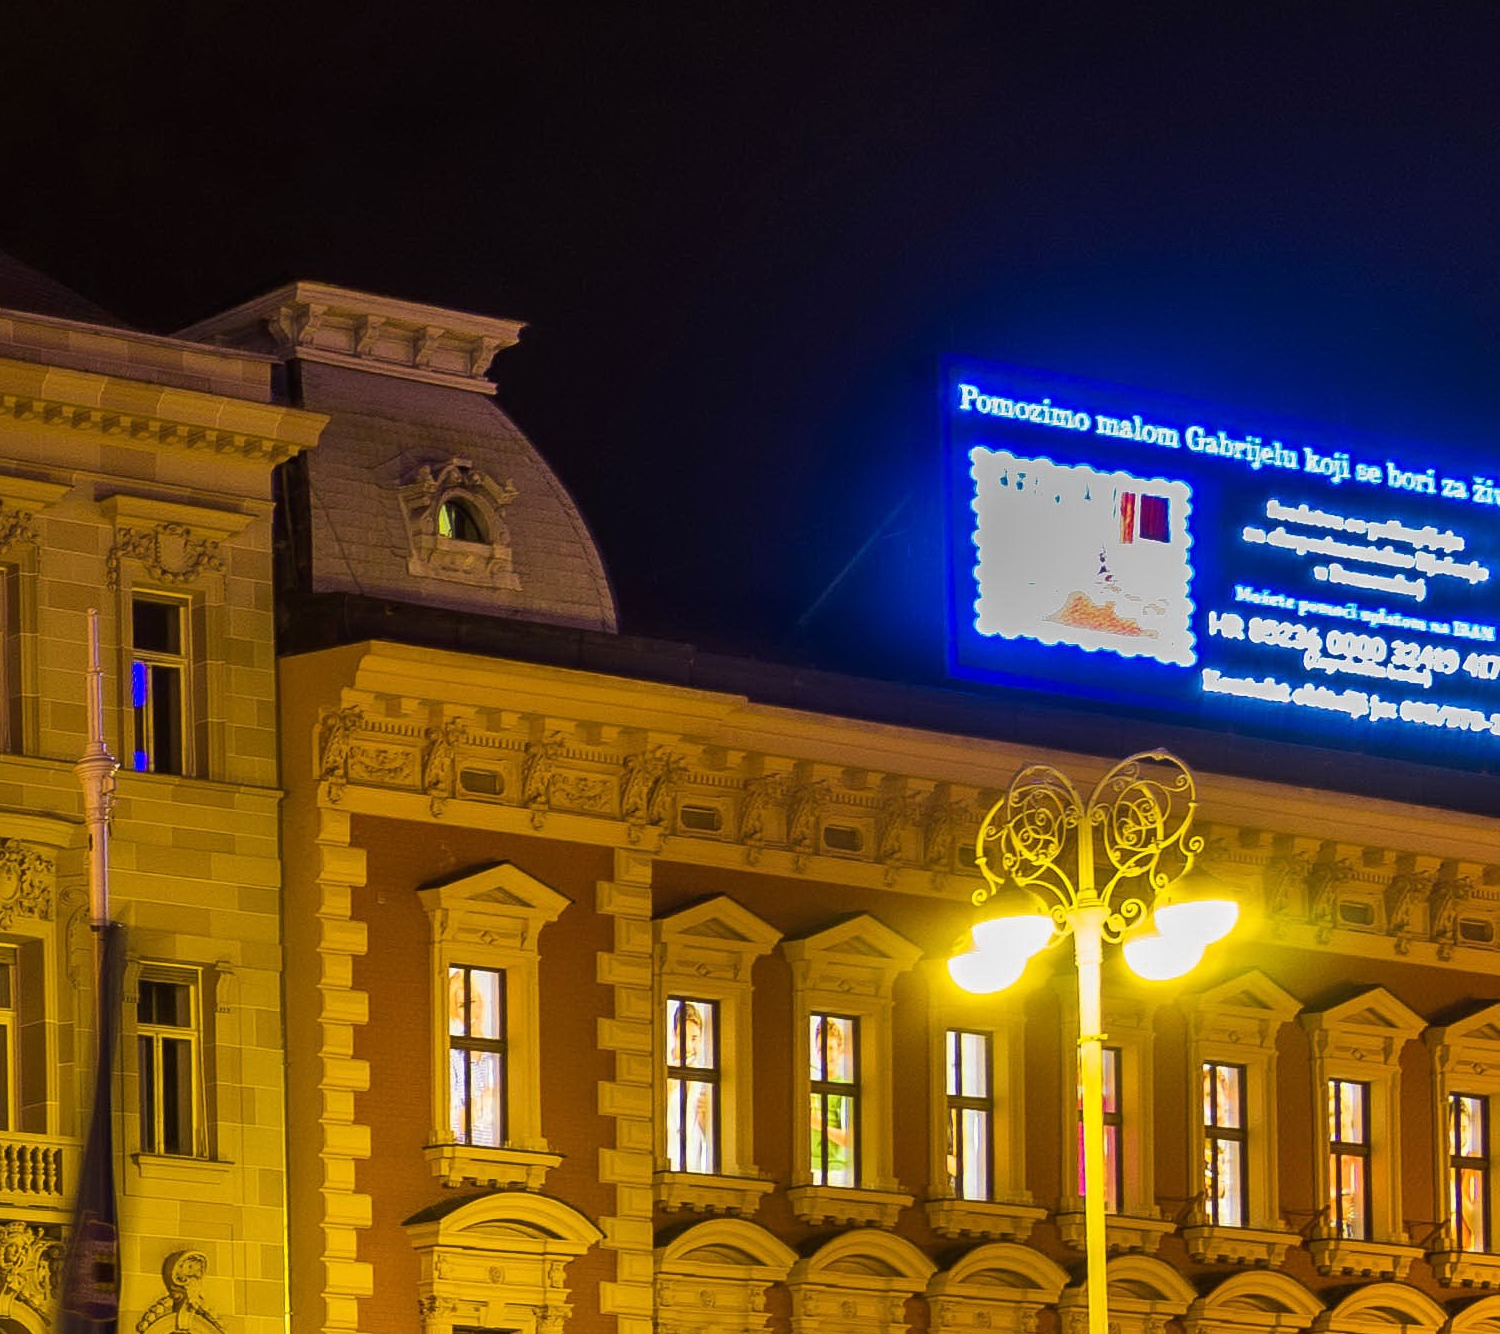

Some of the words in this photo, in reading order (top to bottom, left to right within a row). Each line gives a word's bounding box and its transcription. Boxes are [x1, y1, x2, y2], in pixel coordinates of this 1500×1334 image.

[959, 383, 1091, 431] Pomozimo
[1095, 415, 1181, 448] malom
[1185, 425, 1300, 469] Gabrijelu
[1303, 447, 1351, 484] koji
[1355, 463, 1382, 483] se
[1386, 462, 1436, 494] bori
[1441, 478, 1469, 499] za
